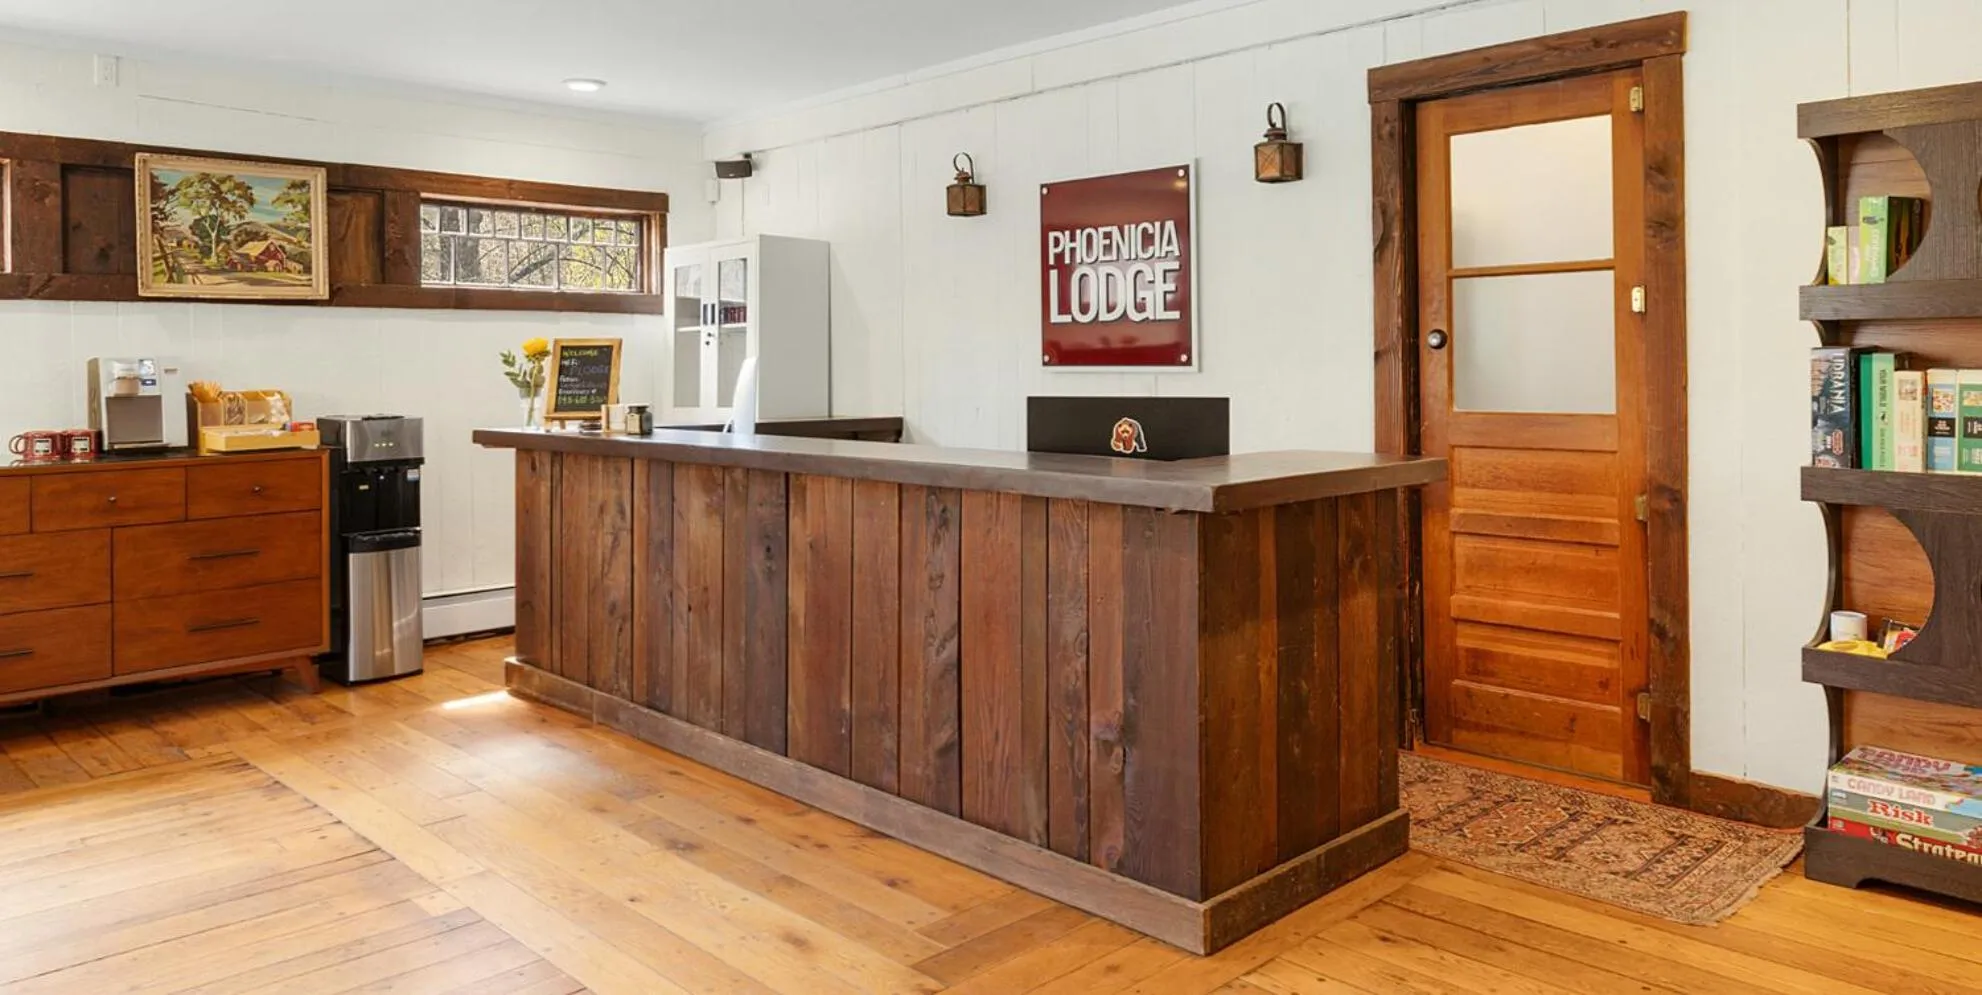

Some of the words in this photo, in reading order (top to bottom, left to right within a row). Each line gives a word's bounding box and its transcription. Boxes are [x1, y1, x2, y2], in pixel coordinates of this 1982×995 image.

[1048, 220, 1180, 265] PHOENICIA
[1050, 261, 1180, 323] LODGE
[1847, 777, 1895, 797] CANDY
[1899, 788, 1937, 806] LAND
[1867, 799, 1934, 827] Risk
[1895, 832, 1982, 865] Strate
